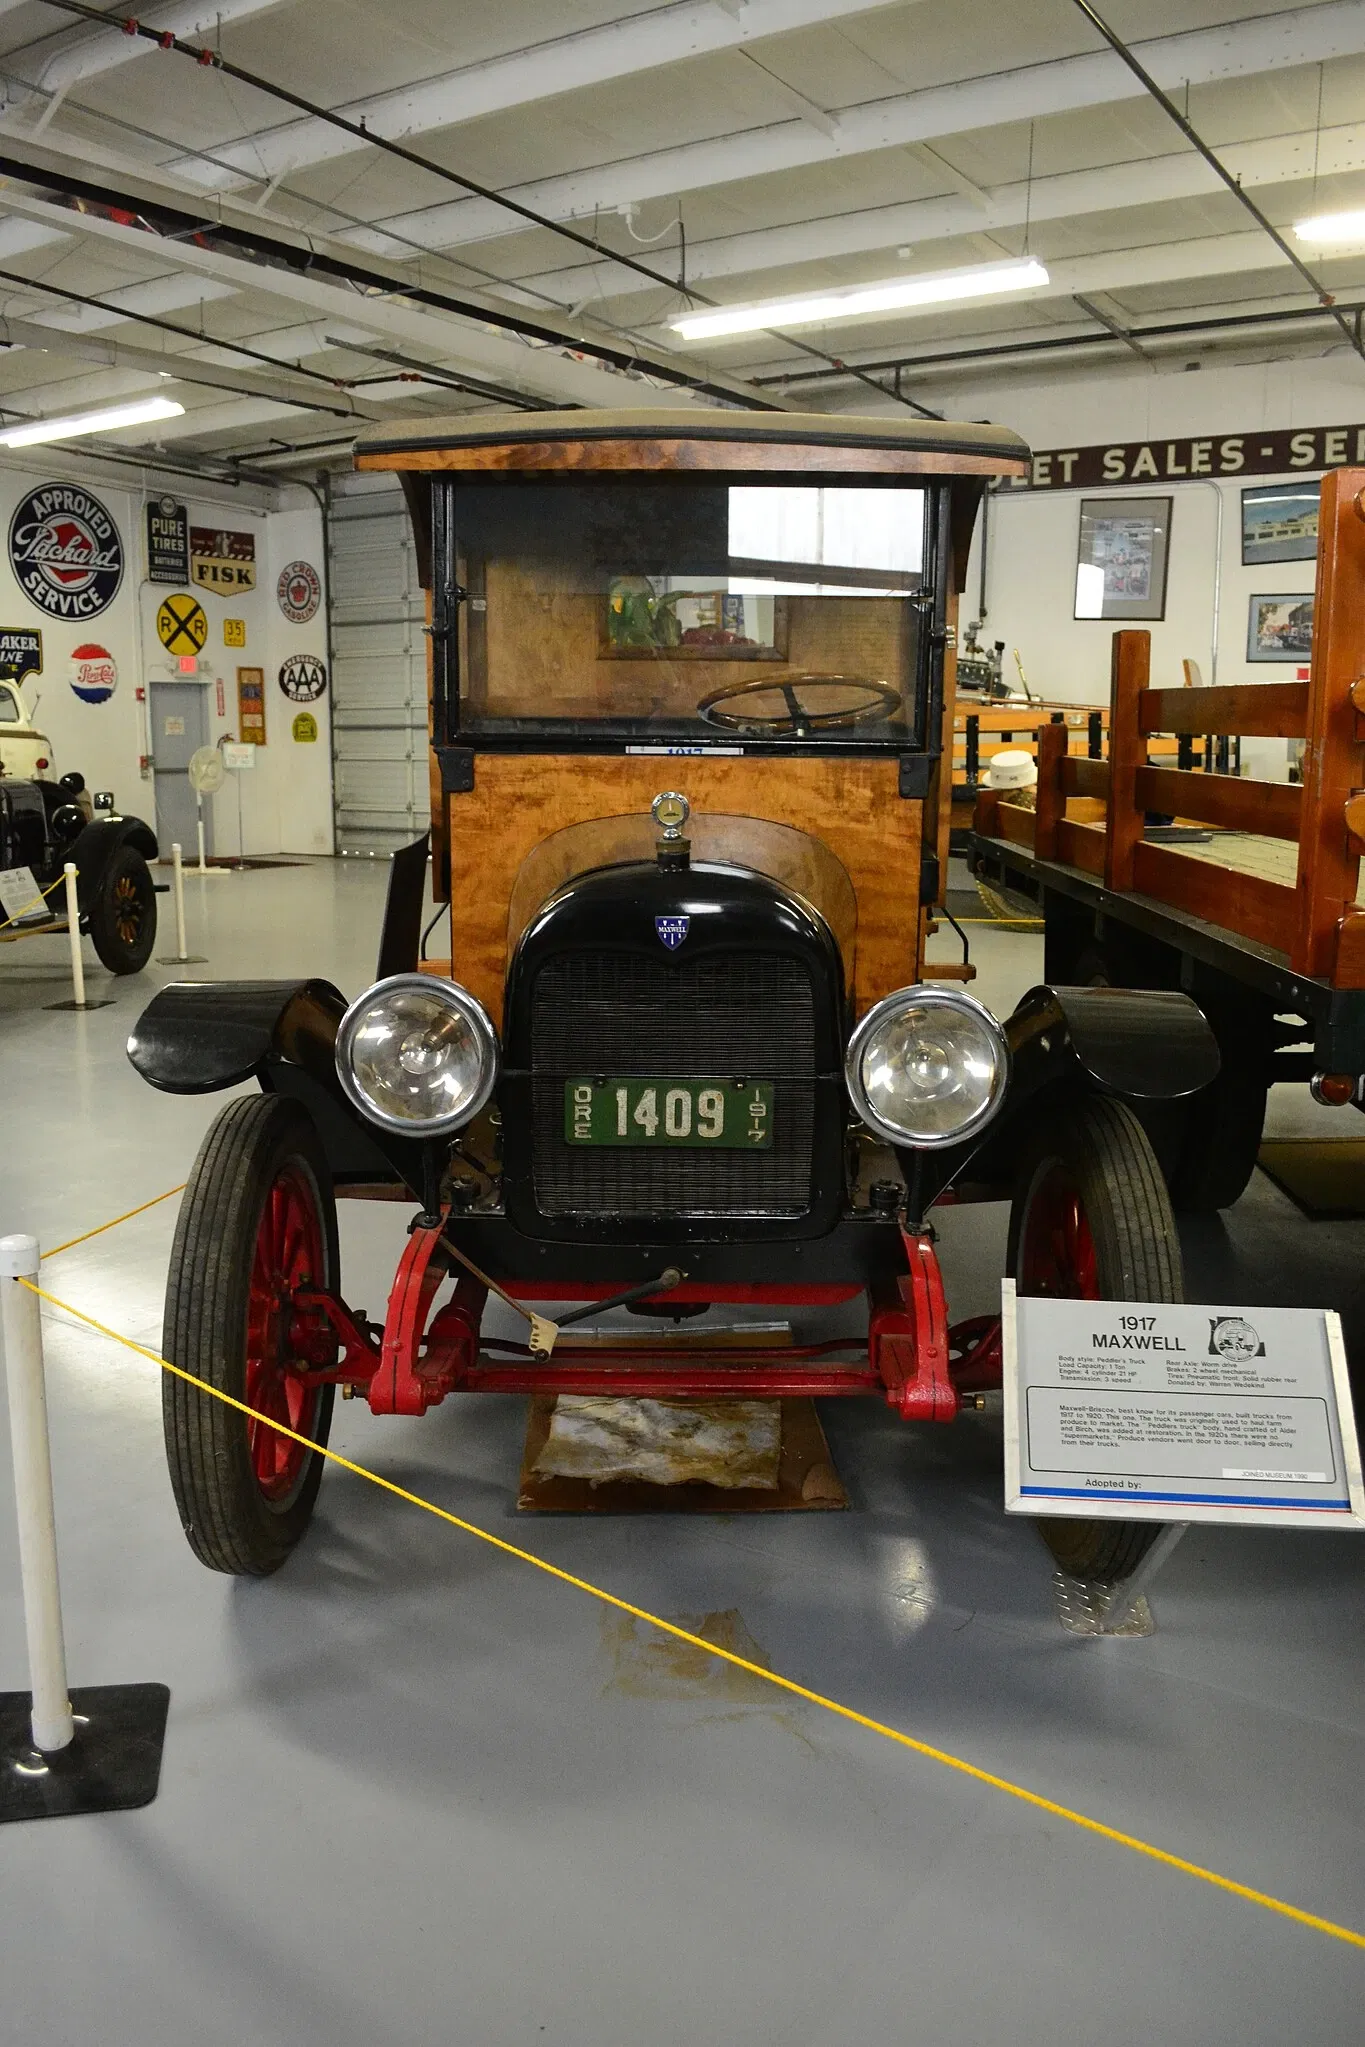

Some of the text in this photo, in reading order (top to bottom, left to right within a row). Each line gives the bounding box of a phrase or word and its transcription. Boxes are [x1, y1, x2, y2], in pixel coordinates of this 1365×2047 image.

[1102, 439, 1245, 480] SALES
[32, 490, 111, 539] APPROVED
[152, 517, 184, 537] PURE
[13, 522, 119, 571] Packard
[152, 536, 185, 552] TIRES
[197, 564, 252, 585] FISK
[292, 564, 319, 595] CROWN
[24, 571, 104, 614] SERVICE
[283, 601, 317, 620] GASOLINE
[161, 616, 204, 636] R R
[227, 622, 241, 636] 35
[286, 663, 320, 692] AAA
[574, 1086, 592, 1139] ORE
[616, 1087, 725, 1138] 1409
[748, 1088, 766, 1143] 1917
[1118, 1316, 1157, 1331] 1917
[1092, 1333, 1186, 1351] MAXWELL
[1077, 1362, 1105, 1370] Capacity:
[1197, 1380, 1207, 1388] by:
[1059, 1405, 1115, 1413] Maxwell-Briscoe,
[1085, 1479, 1142, 1490] Adopted by:
